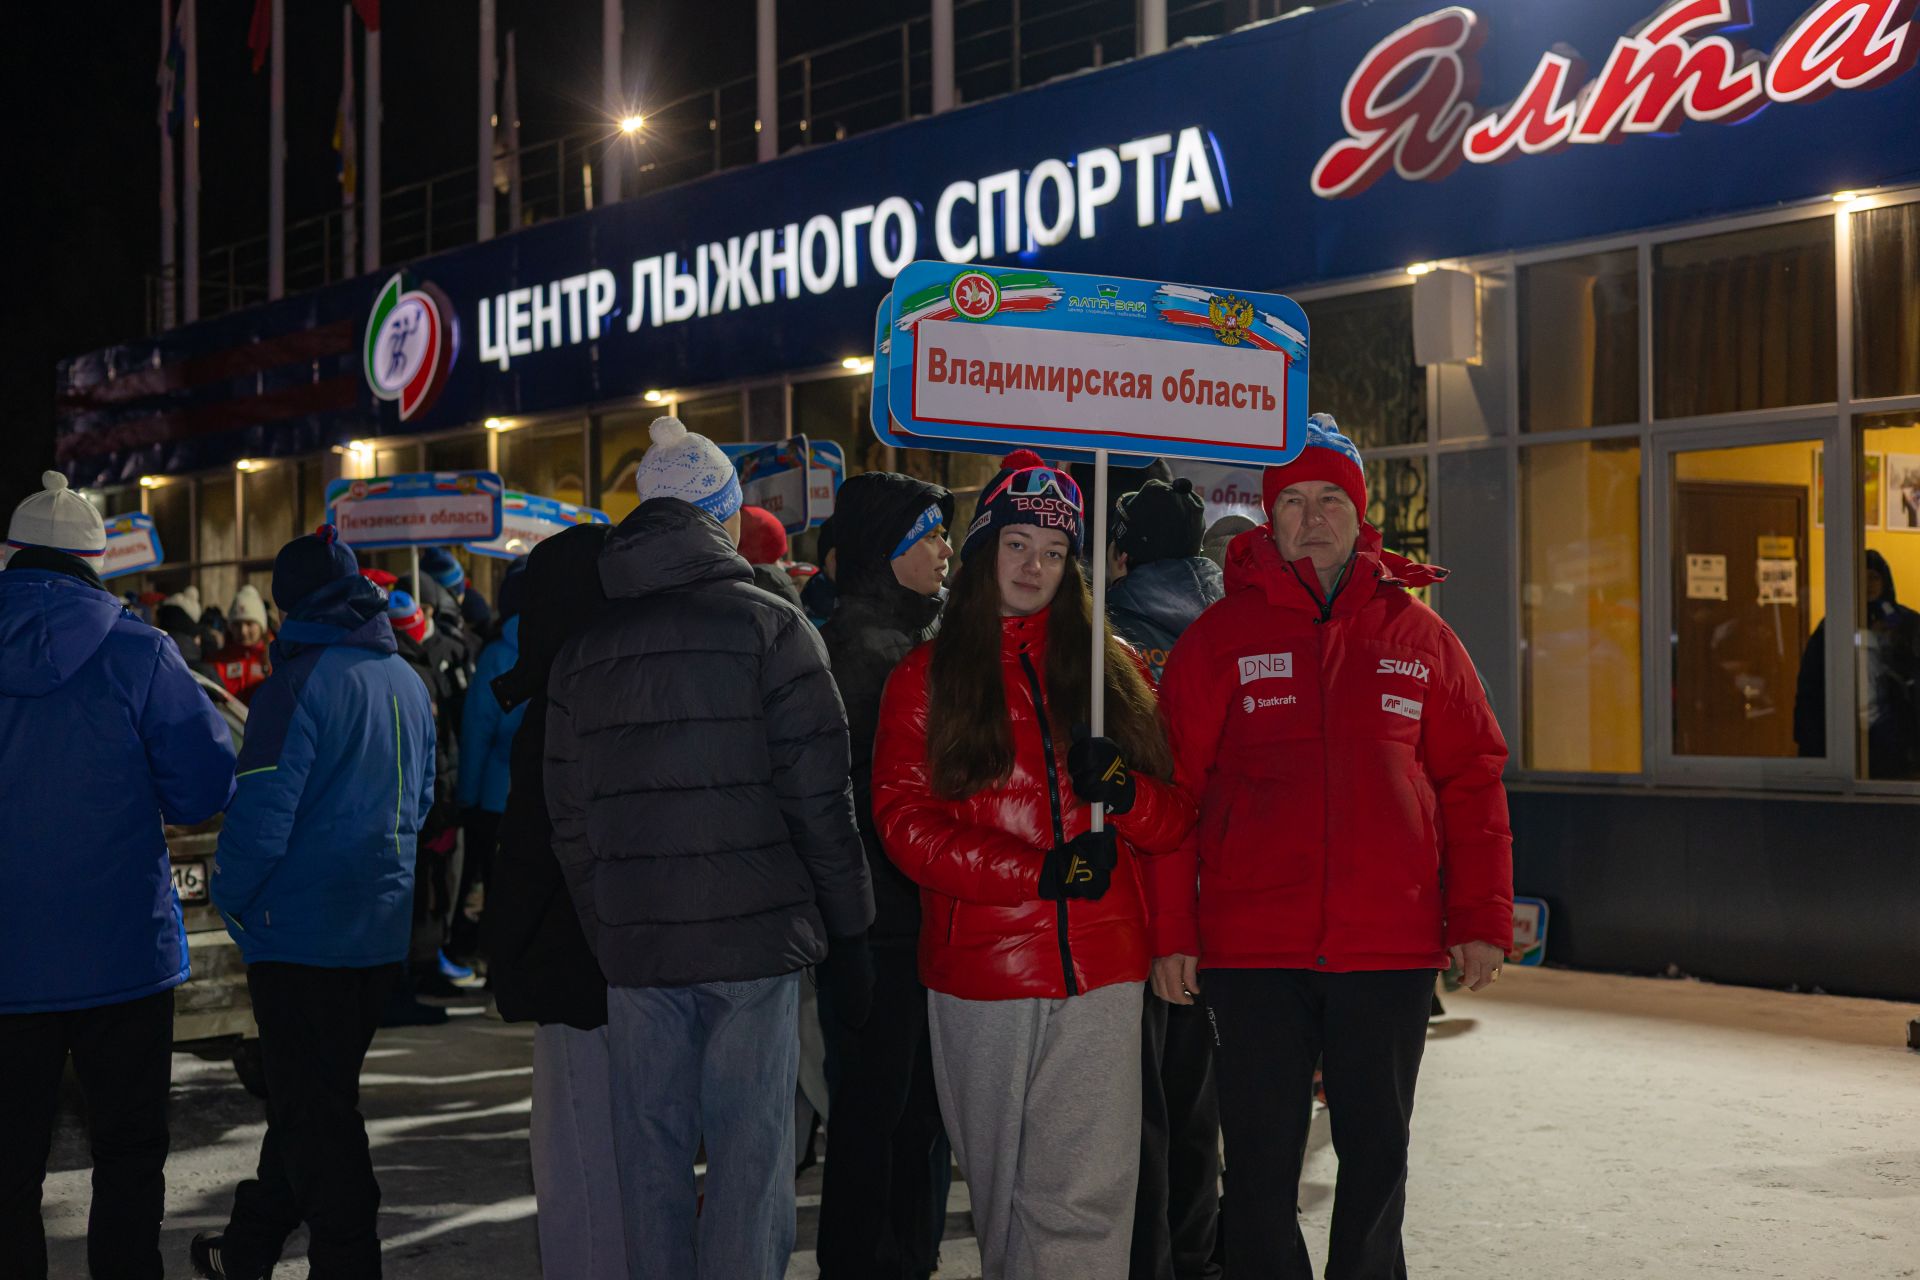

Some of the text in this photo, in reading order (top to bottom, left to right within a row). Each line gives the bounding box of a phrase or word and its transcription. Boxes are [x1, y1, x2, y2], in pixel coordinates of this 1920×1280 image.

[478, 126, 1223, 372] ЦЕНТР ЛЫЖНОГО СПОРТА
[928, 347, 1276, 411] Владимирская область
[1212, 484, 1262, 506] обла
[341, 508, 489, 529] Пензенская область
[1035, 511, 1077, 536] TEAM
[1245, 654, 1286, 678] DNB
[1257, 695, 1297, 708] Statkraft
